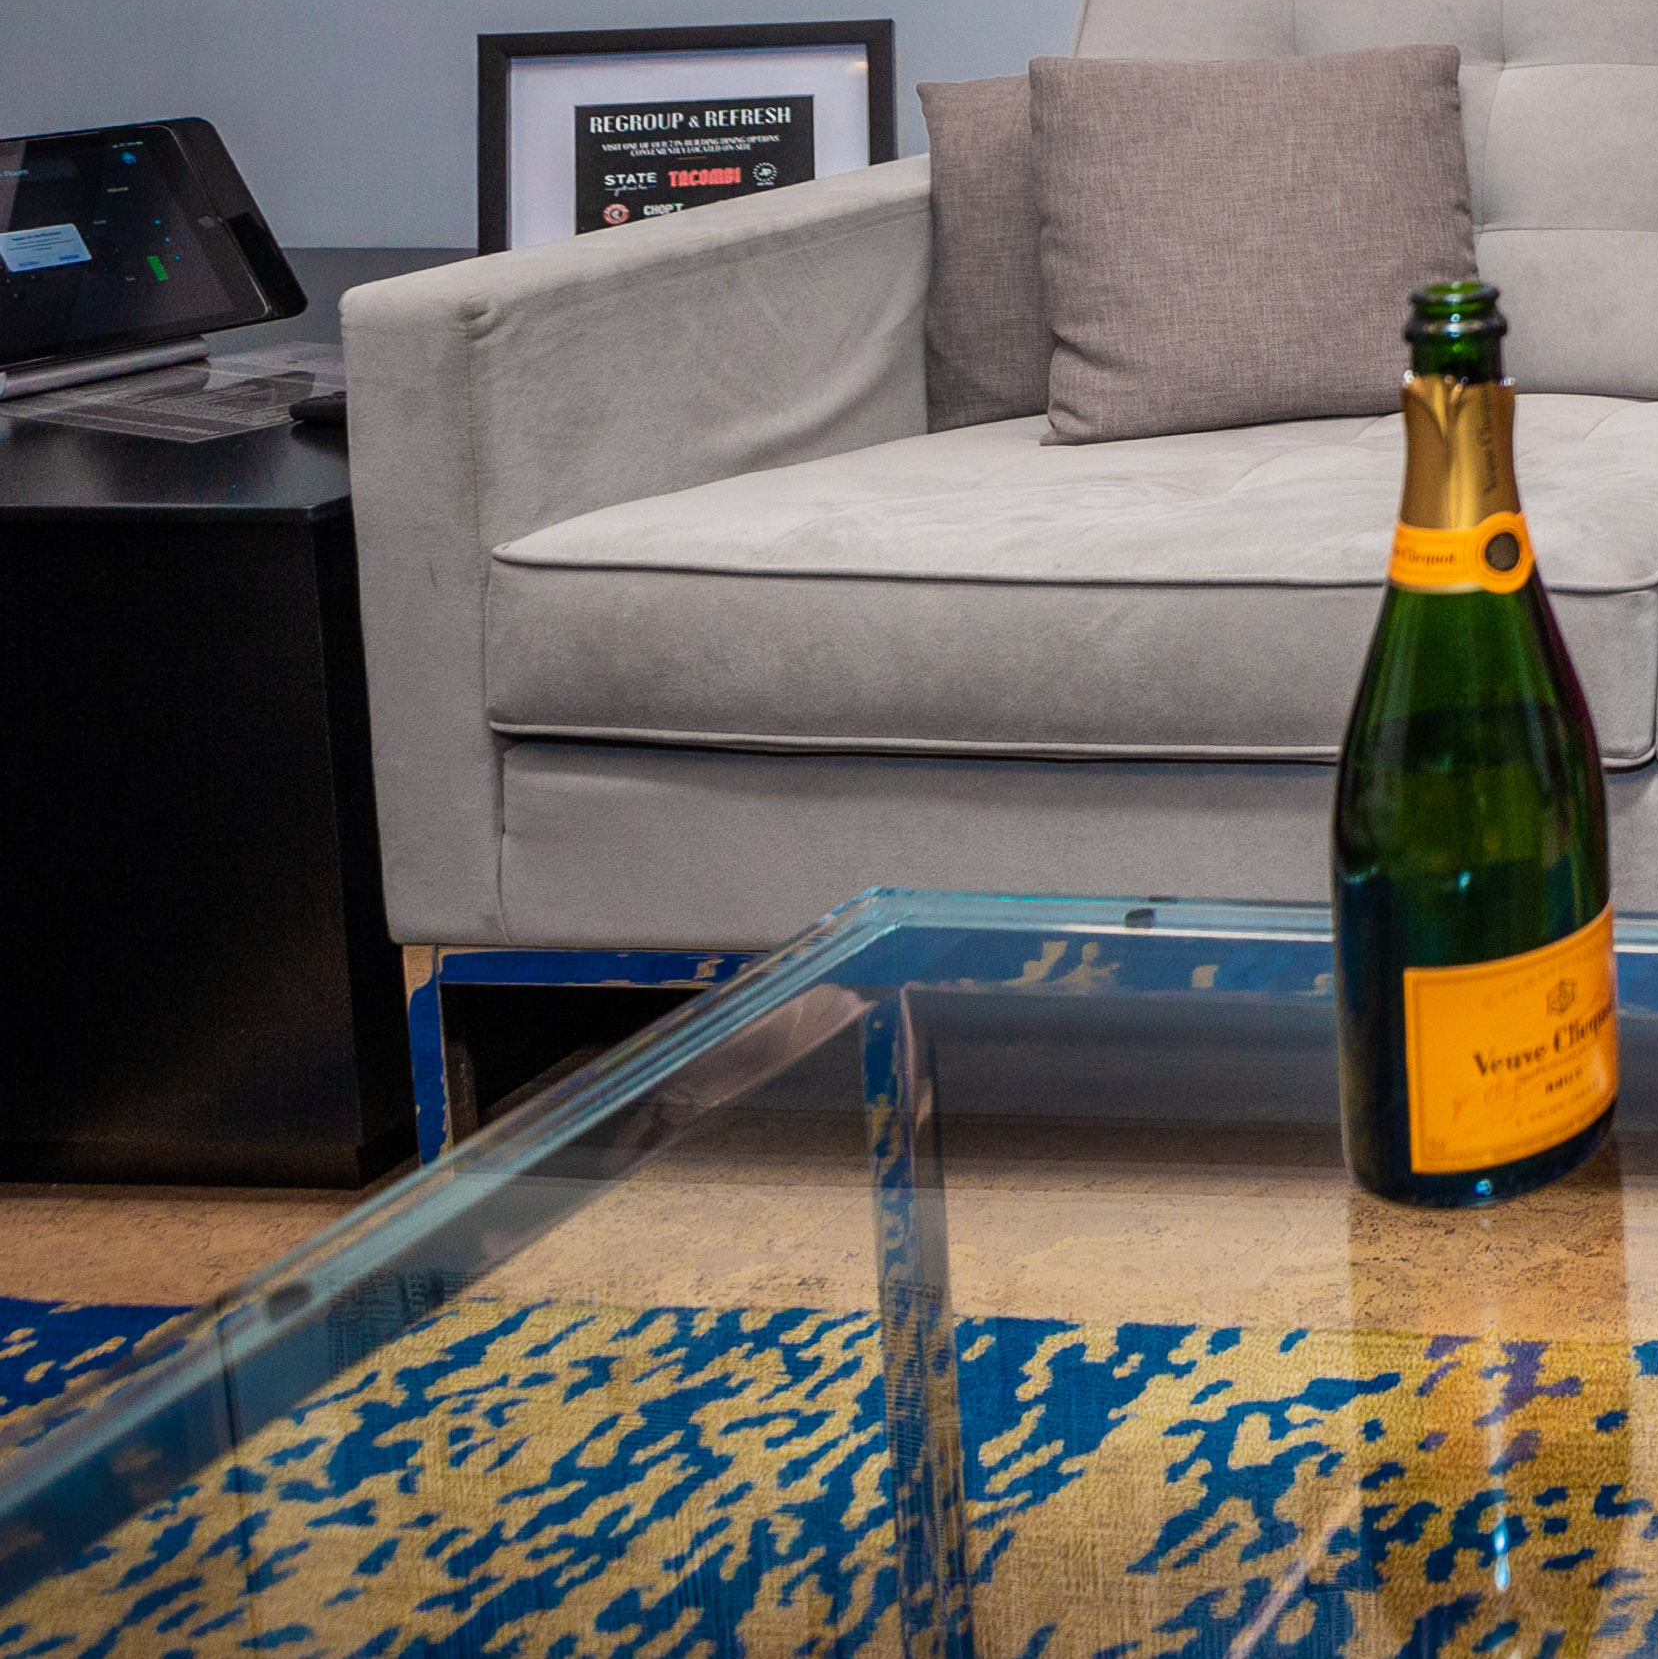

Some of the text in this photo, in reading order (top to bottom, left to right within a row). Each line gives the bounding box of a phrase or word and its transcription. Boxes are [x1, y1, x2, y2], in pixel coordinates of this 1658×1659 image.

[590, 106, 791, 134] REGROUP & REFRESH
[604, 172, 657, 187] STATE
[1474, 1045, 1548, 1077] Veuve
